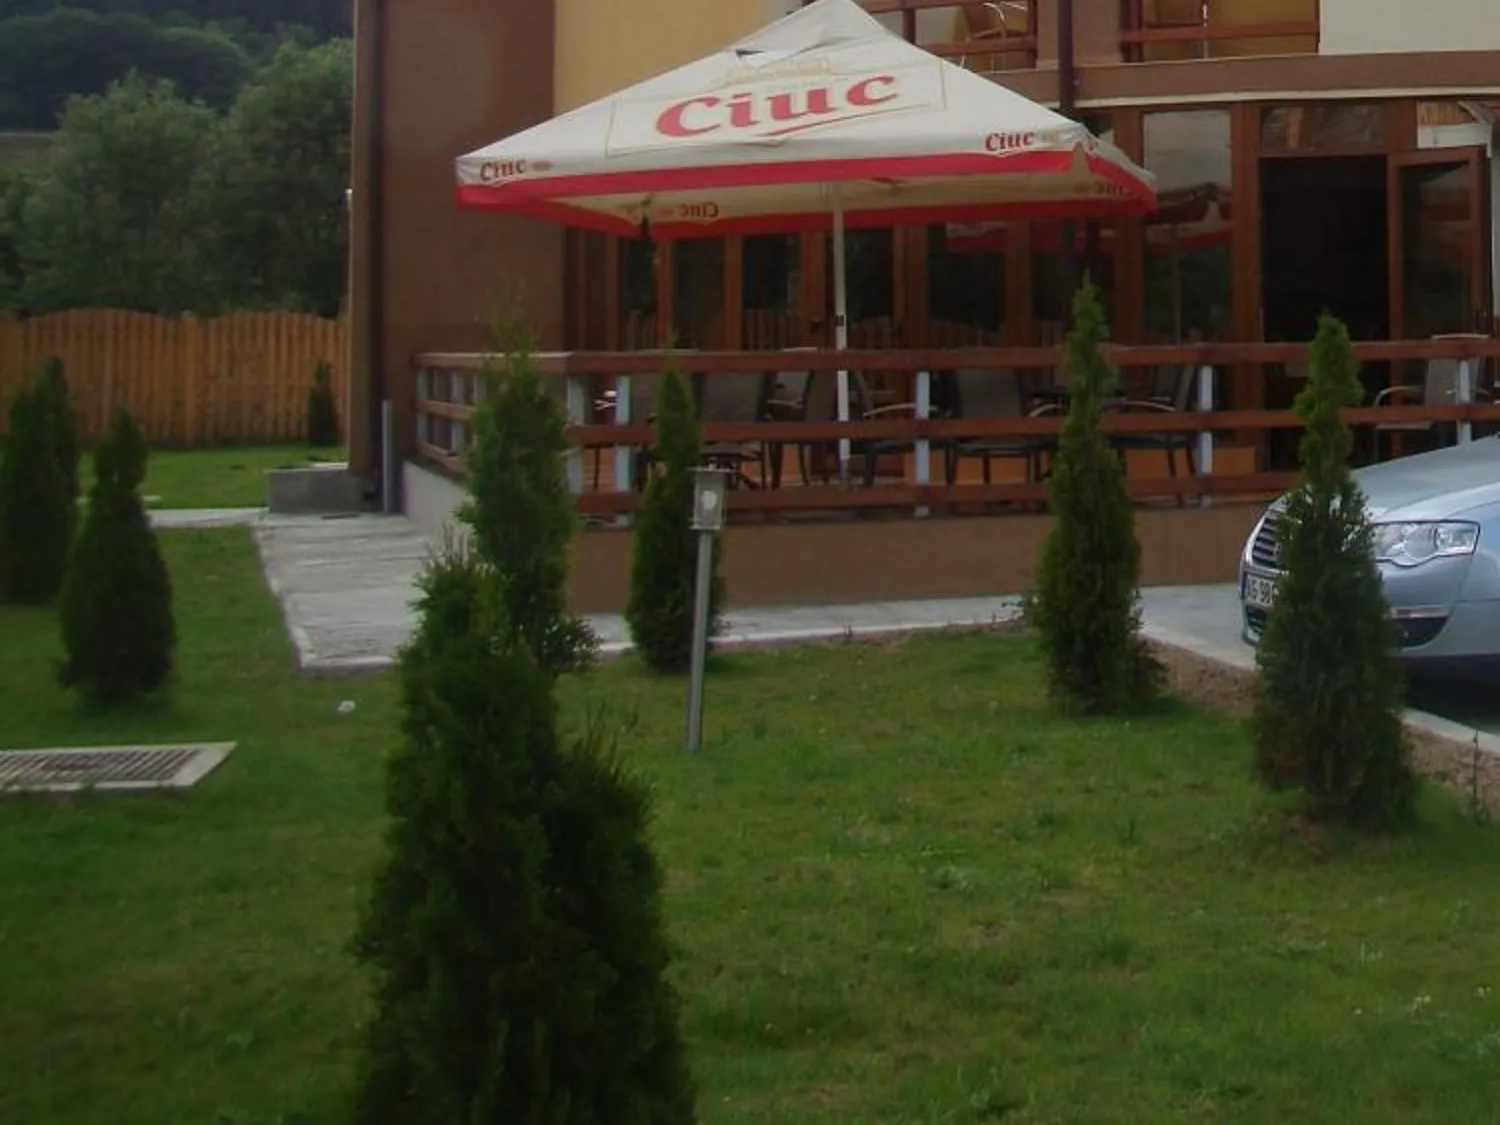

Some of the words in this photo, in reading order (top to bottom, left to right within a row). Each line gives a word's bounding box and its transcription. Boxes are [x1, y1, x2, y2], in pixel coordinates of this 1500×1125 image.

[655, 74, 898, 138] Ciuc
[985, 131, 1035, 151] Ciuc
[480, 158, 526, 182] Ciuc
